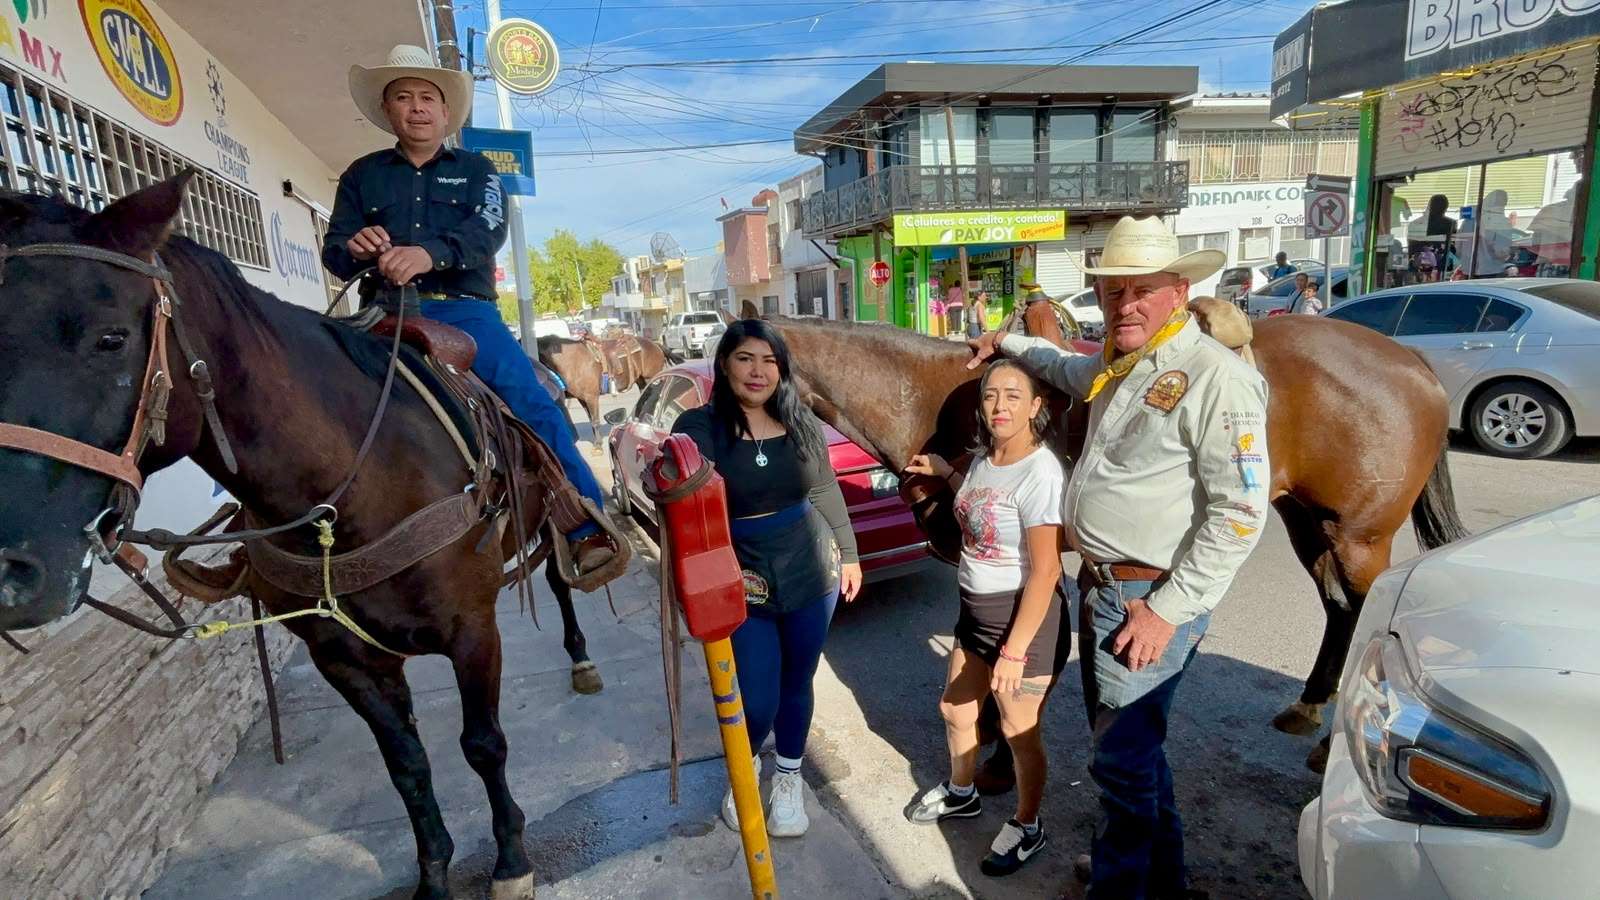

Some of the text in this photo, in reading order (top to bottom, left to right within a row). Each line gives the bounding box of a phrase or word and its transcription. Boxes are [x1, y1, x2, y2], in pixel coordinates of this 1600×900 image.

[18, 27, 68, 84] MX
[511, 66, 541, 77] Modelo
[217, 149, 249, 184] LEAGUE
[437, 177, 467, 185] Wrangler
[1189, 190, 1271, 206] DREDONES
[955, 227, 1015, 241] PAYJOY
[271, 210, 320, 287] Corona
[870, 268, 890, 279] ALTO
